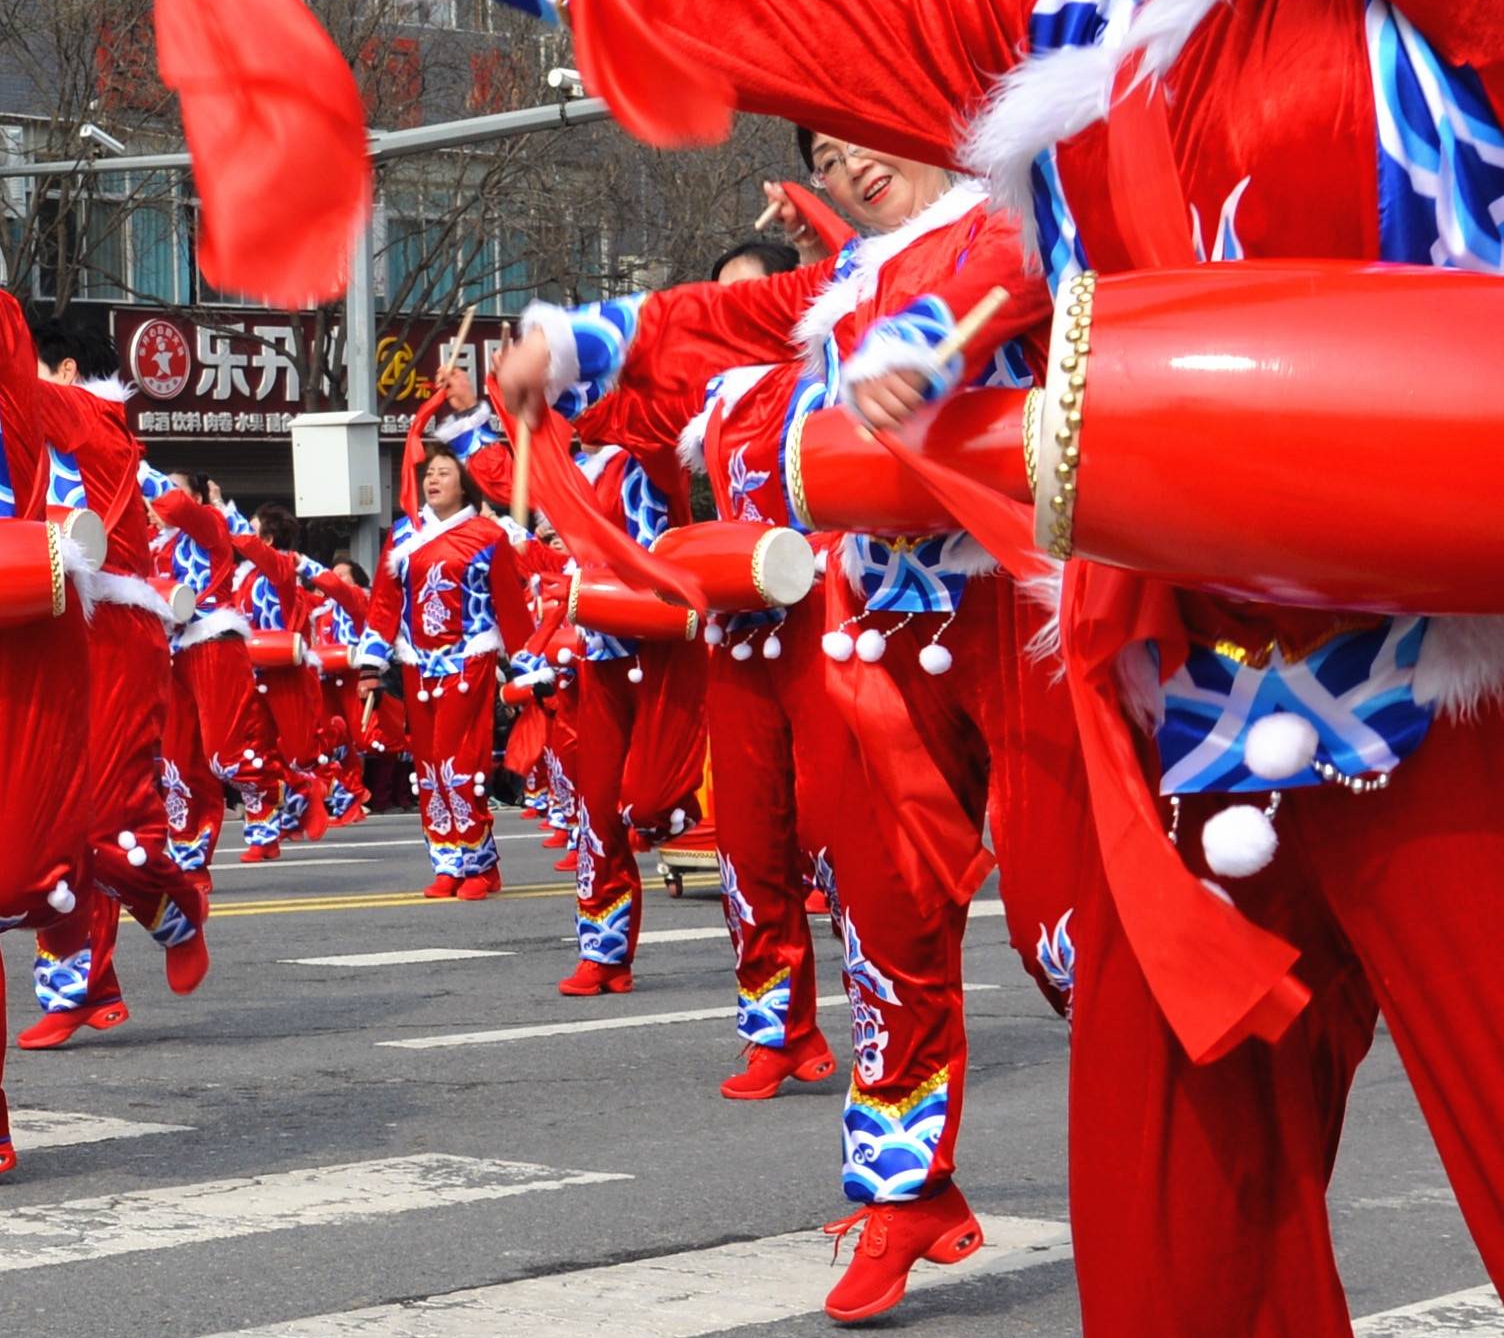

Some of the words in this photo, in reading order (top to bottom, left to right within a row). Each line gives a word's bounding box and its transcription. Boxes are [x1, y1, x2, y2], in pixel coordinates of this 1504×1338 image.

[139, 411, 170, 432] 啤酒
[172, 411, 202, 432] 饮料
[235, 412, 264, 432] 水果
